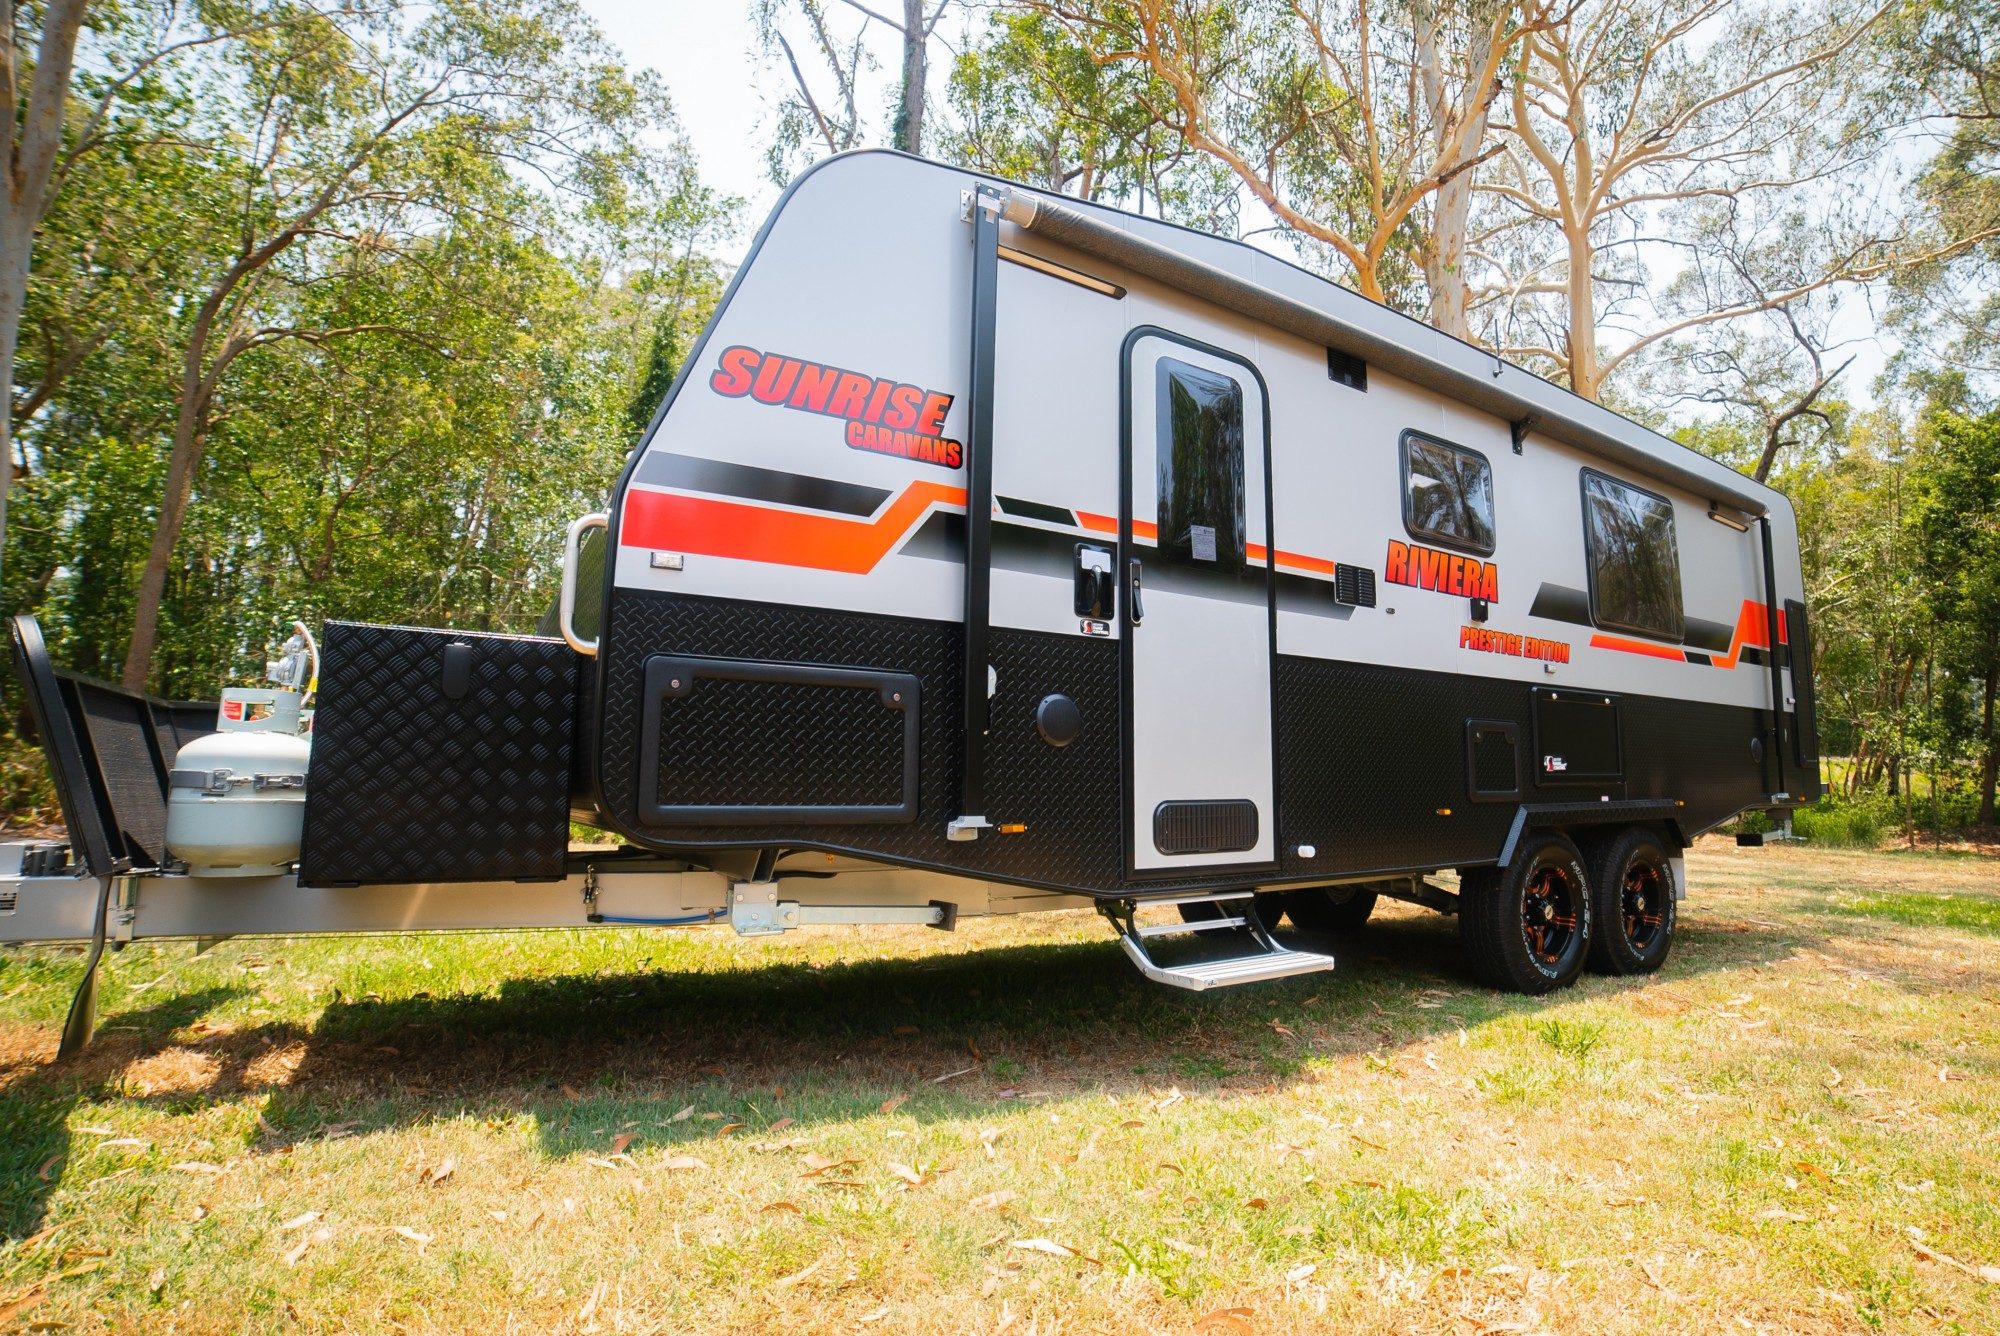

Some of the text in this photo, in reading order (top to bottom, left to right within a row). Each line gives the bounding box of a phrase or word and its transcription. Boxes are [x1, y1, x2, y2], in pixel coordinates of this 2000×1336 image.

[710, 346, 954, 436] SUNRISE
[847, 420, 961, 468] CARAVANS
[1385, 539, 1499, 604] RIVIERA
[1459, 626, 1571, 664] PRESTIGE EDITION
